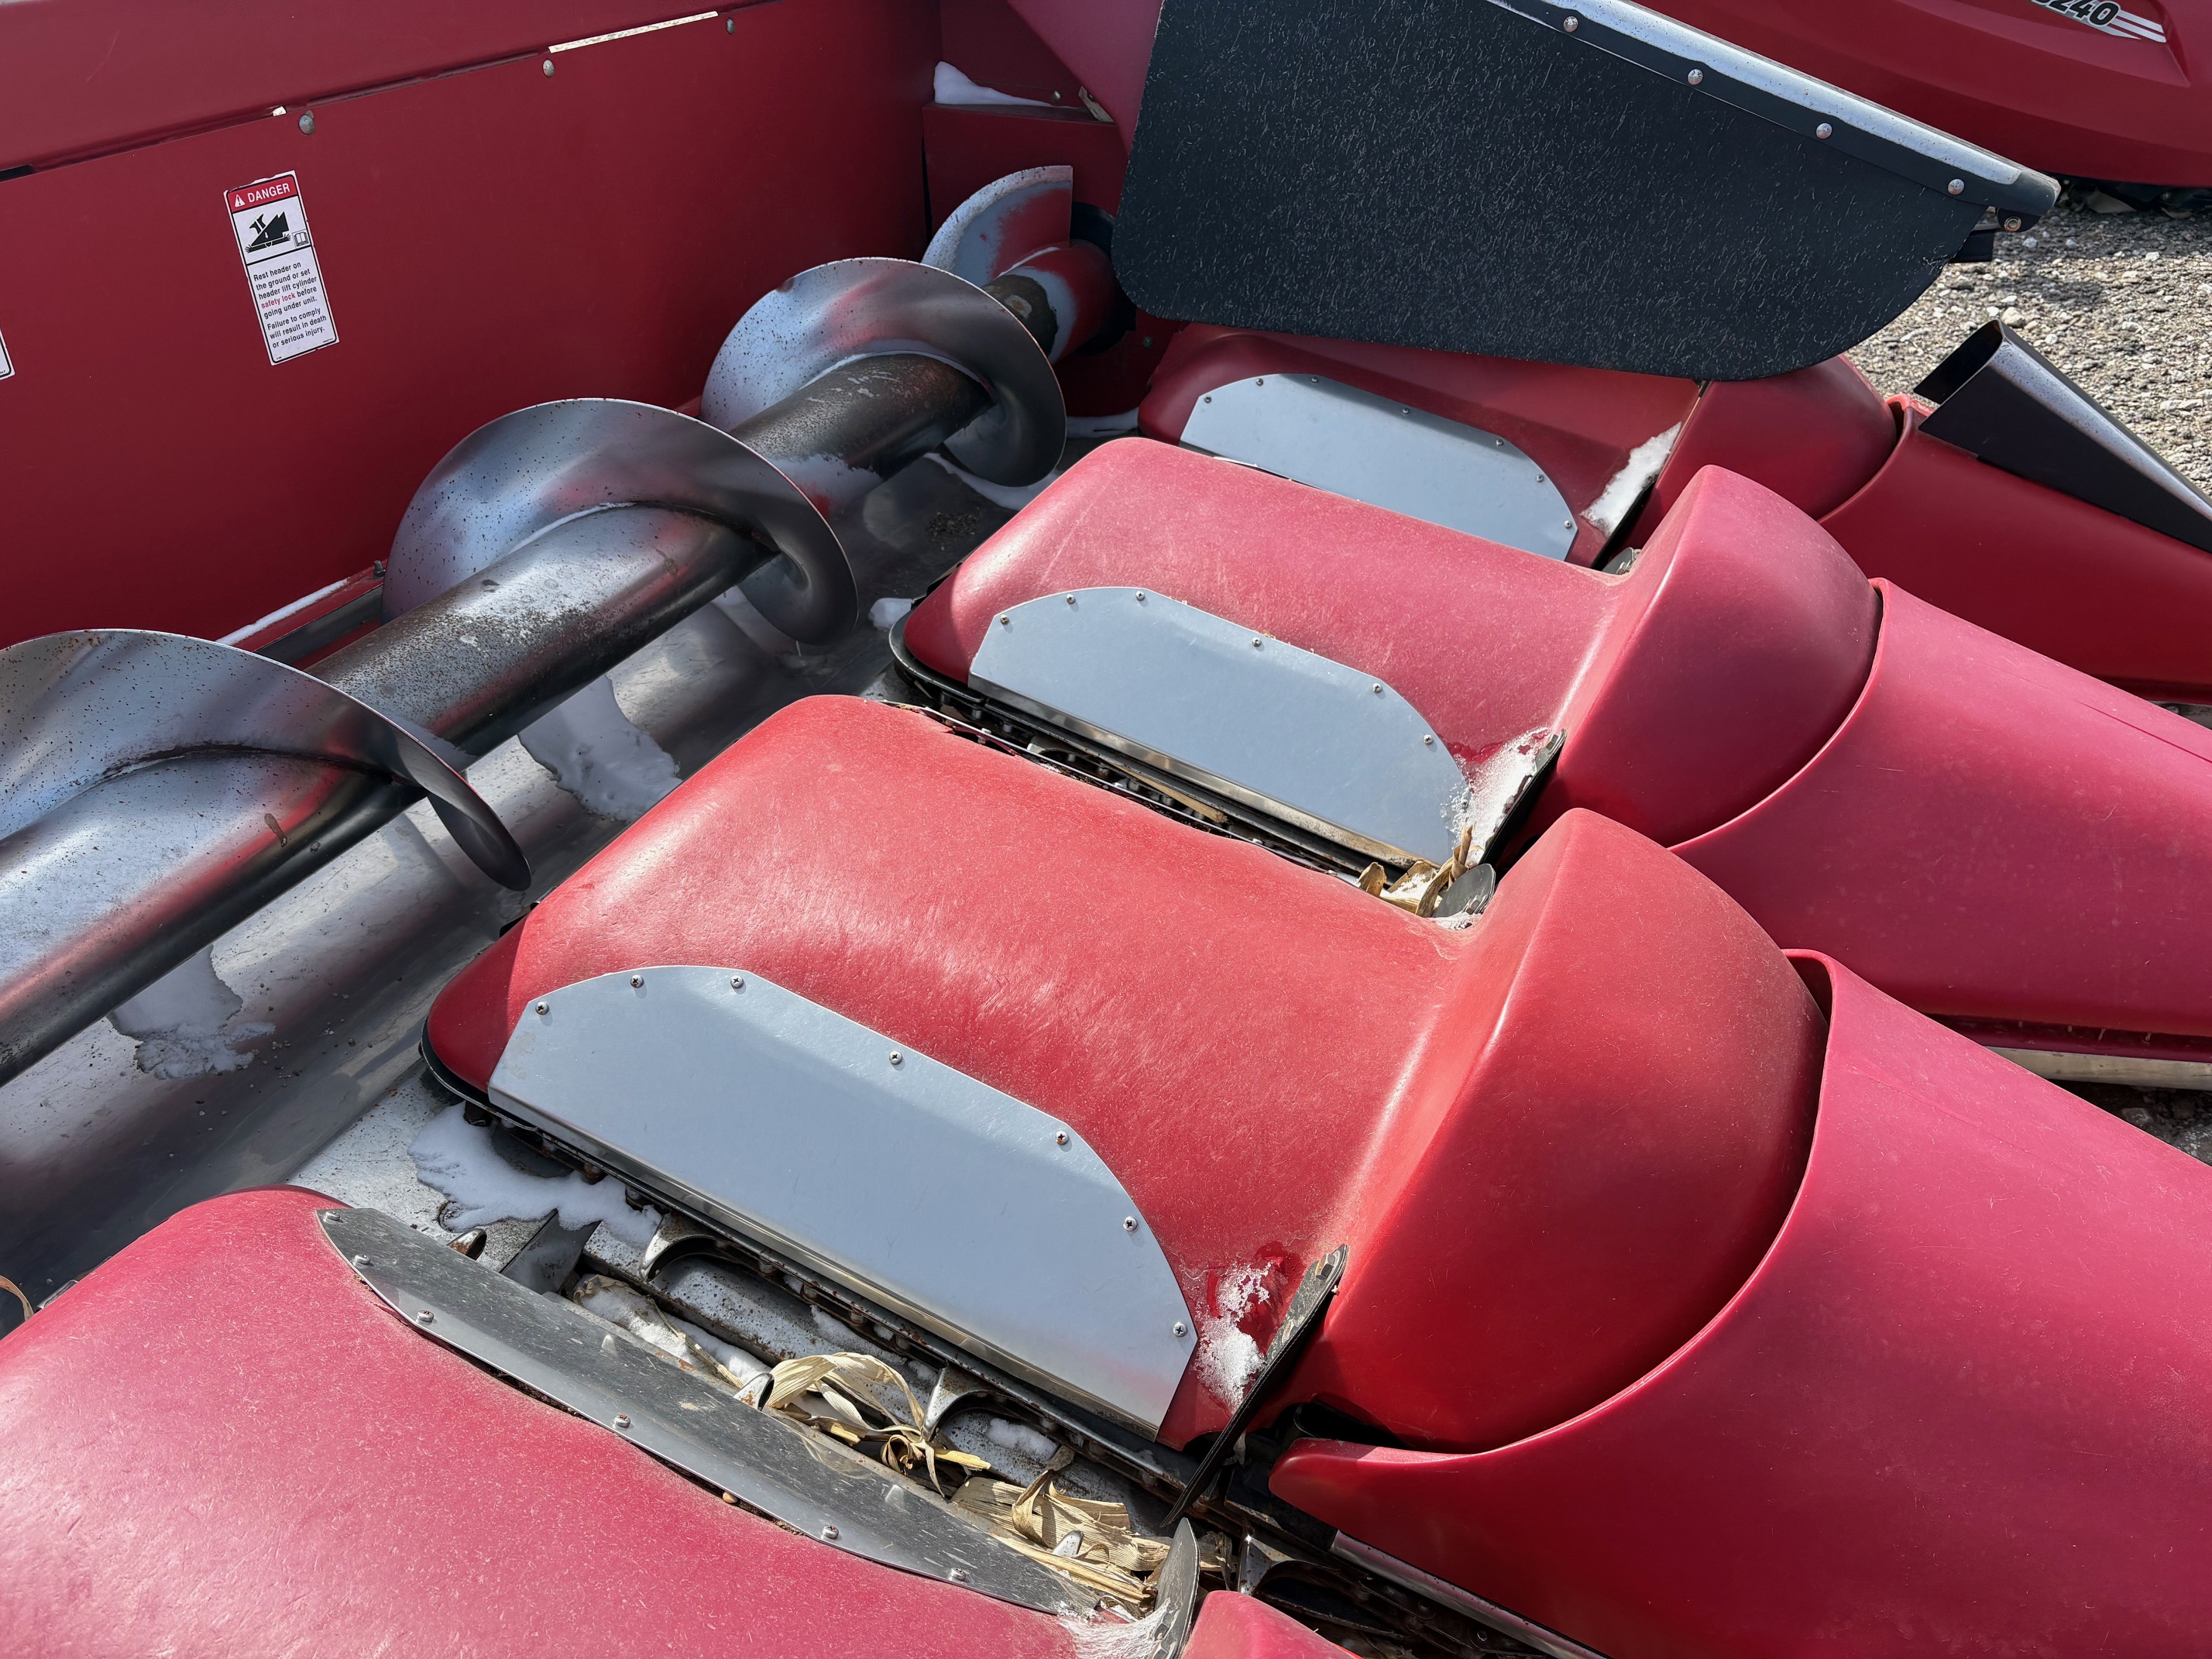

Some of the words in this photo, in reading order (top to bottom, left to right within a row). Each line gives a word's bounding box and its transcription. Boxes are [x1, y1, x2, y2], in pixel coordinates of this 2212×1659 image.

[2032, 0, 2120, 26] 240
[247, 183, 290, 202] DANGER
[253, 272, 268, 281] Rest
[270, 266, 291, 276] header
[268, 274, 290, 288] ground
[259, 288, 280, 300] header
[293, 276, 317, 289] cylinder
[261, 298, 280, 308] safety
[282, 293, 296, 301] lock
[297, 287, 317, 297] before
[264, 308, 282, 319] going
[283, 301, 301, 311] under
[304, 296, 317, 304] unit.
[267, 319, 289, 330] Failure
[299, 307, 321, 320] comply
[270, 330, 281, 339] will
[283, 324, 301, 335] result
[310, 315, 327, 325] death
[281, 333, 304, 345] serious
[305, 326, 325, 336] injury.
